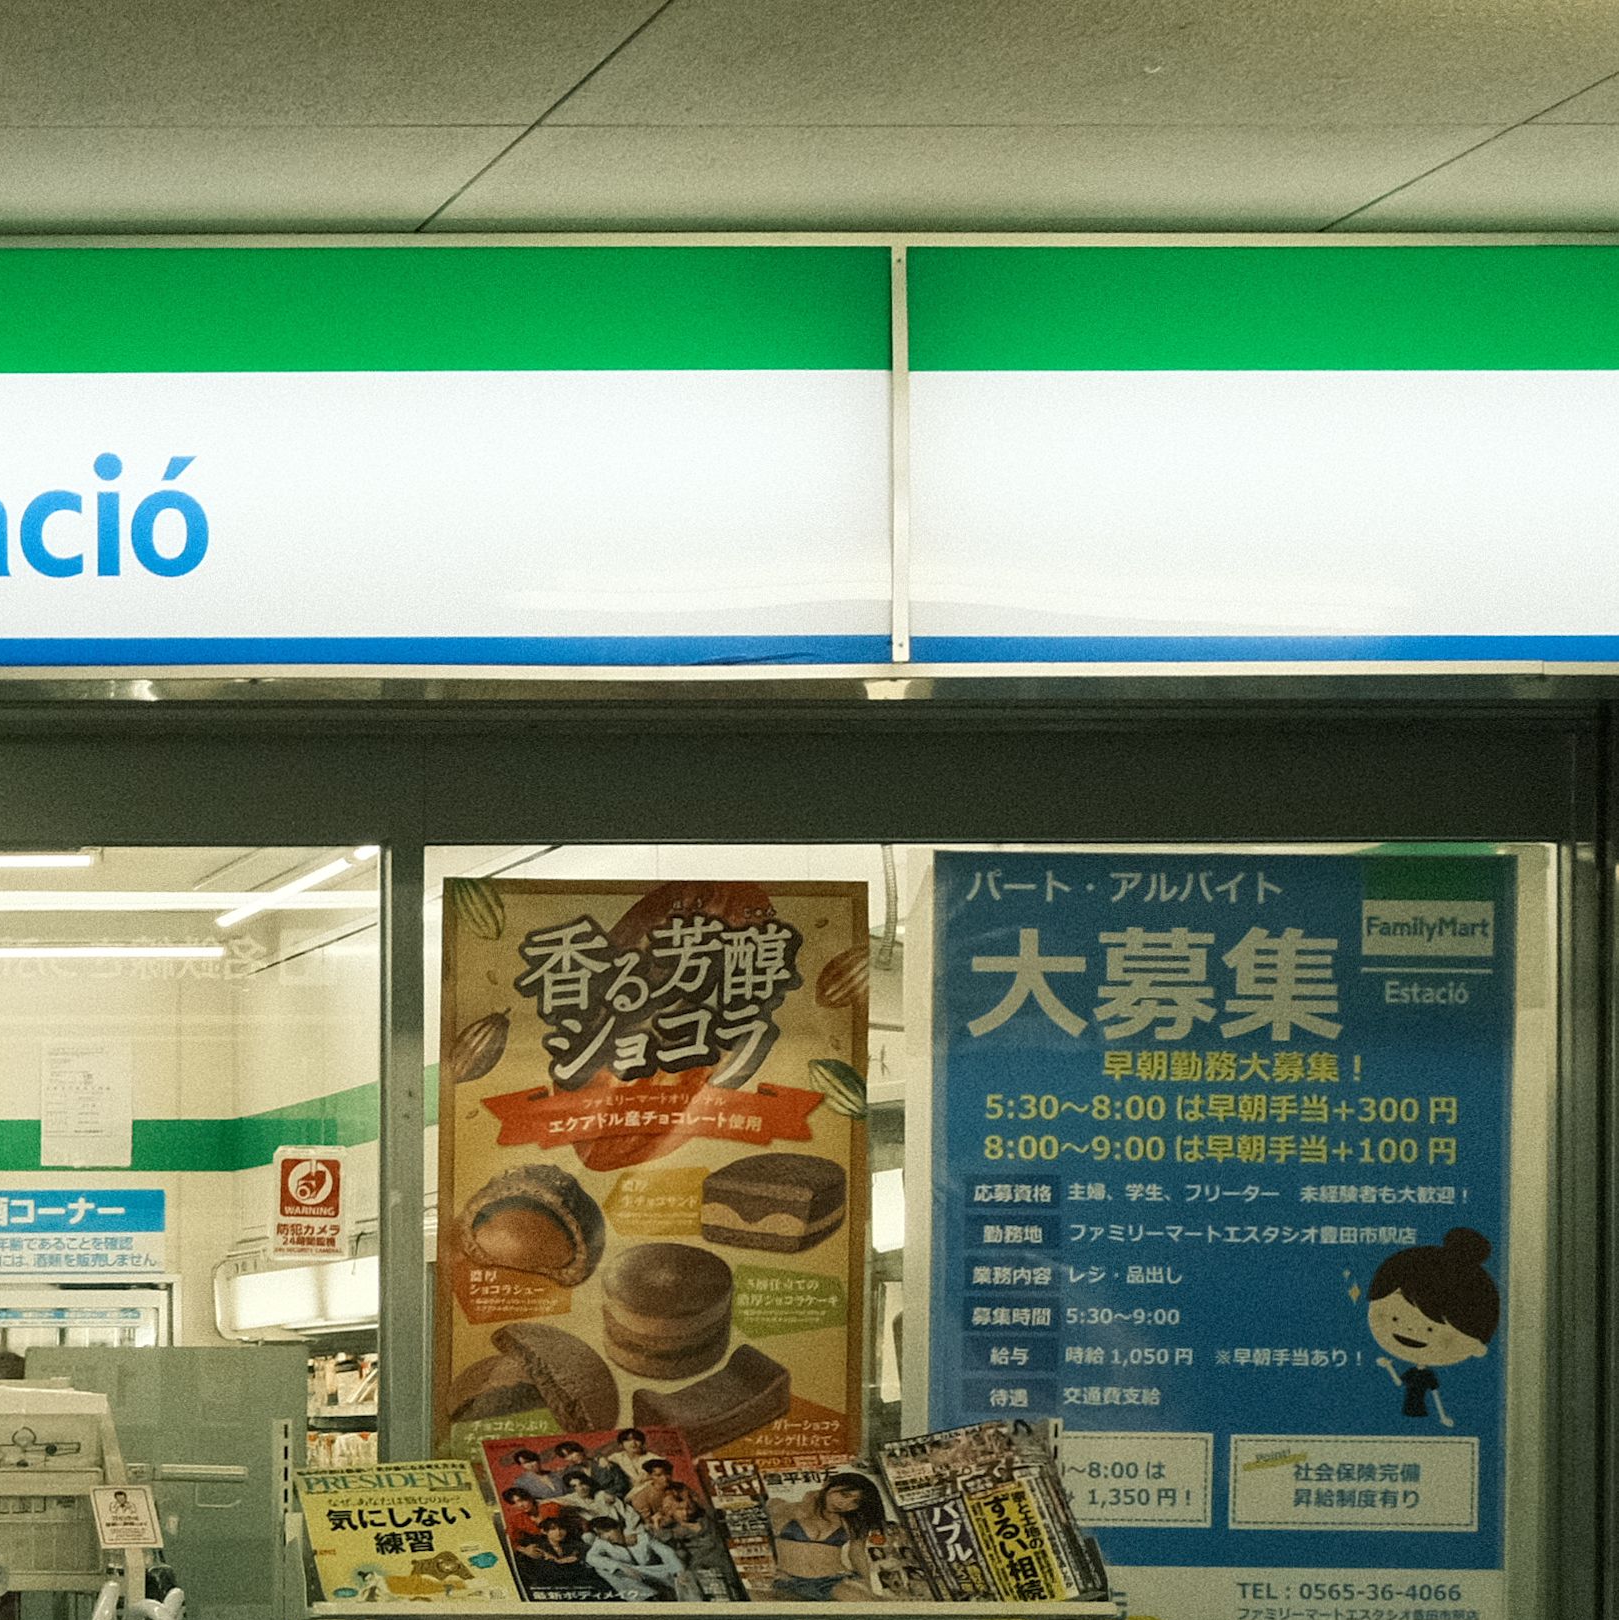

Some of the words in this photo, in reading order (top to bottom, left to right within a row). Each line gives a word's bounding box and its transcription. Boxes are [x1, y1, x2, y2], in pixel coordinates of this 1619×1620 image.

[966, 870, 1284, 904] パート・アルバイト
[1365, 915, 1490, 942] FamilyMart
[522, 917, 795, 1015] 香る芳醇
[966, 926, 1343, 1042] 大募集
[1384, 980, 1470, 1005] Estació
[545, 1004, 770, 1088] ショコラ
[547, 1111, 763, 1135] エクアドル産チョコレート使用
[972, 1184, 1053, 1204] 応募資格
[1066, 1183, 1281, 1204] 主婦、学生、フリーター
[284, 1206, 336, 1216] WARNING
[275, 1222, 341, 1236] 防犯カメラ
[982, 1225, 1044, 1245] 勤務地
[1069, 1224, 1417, 1246] ファミリーマートエスタシオ豊田市駅店
[972, 1265, 1053, 1286] 業務内容
[1067, 1265, 1184, 1285] レジ・品出し
[971, 1306, 1052, 1326] 募集時間
[989, 1346, 1030, 1366] 給与
[1065, 1346, 1104, 1366] 時給
[1110, 1347, 1170, 1368] 1,050
[1173, 1347, 1194, 1366] 円
[989, 1387, 1029, 1408] 待遇
[1062, 1386, 1163, 1406] 交通費支給
[304, 1470, 465, 1493] PRESIDENT
[1145, 1462, 1166, 1480] は
[1292, 1463, 1422, 1483] 社会保険完備
[1087, 1488, 1151, 1509] 1,350
[1292, 1488, 1422, 1511] 昇給制度有り
[326, 1504, 471, 1532] 気にしない
[373, 1530, 435, 1556] 練習
[983, 1496, 1049, 1601] ずるい相続
